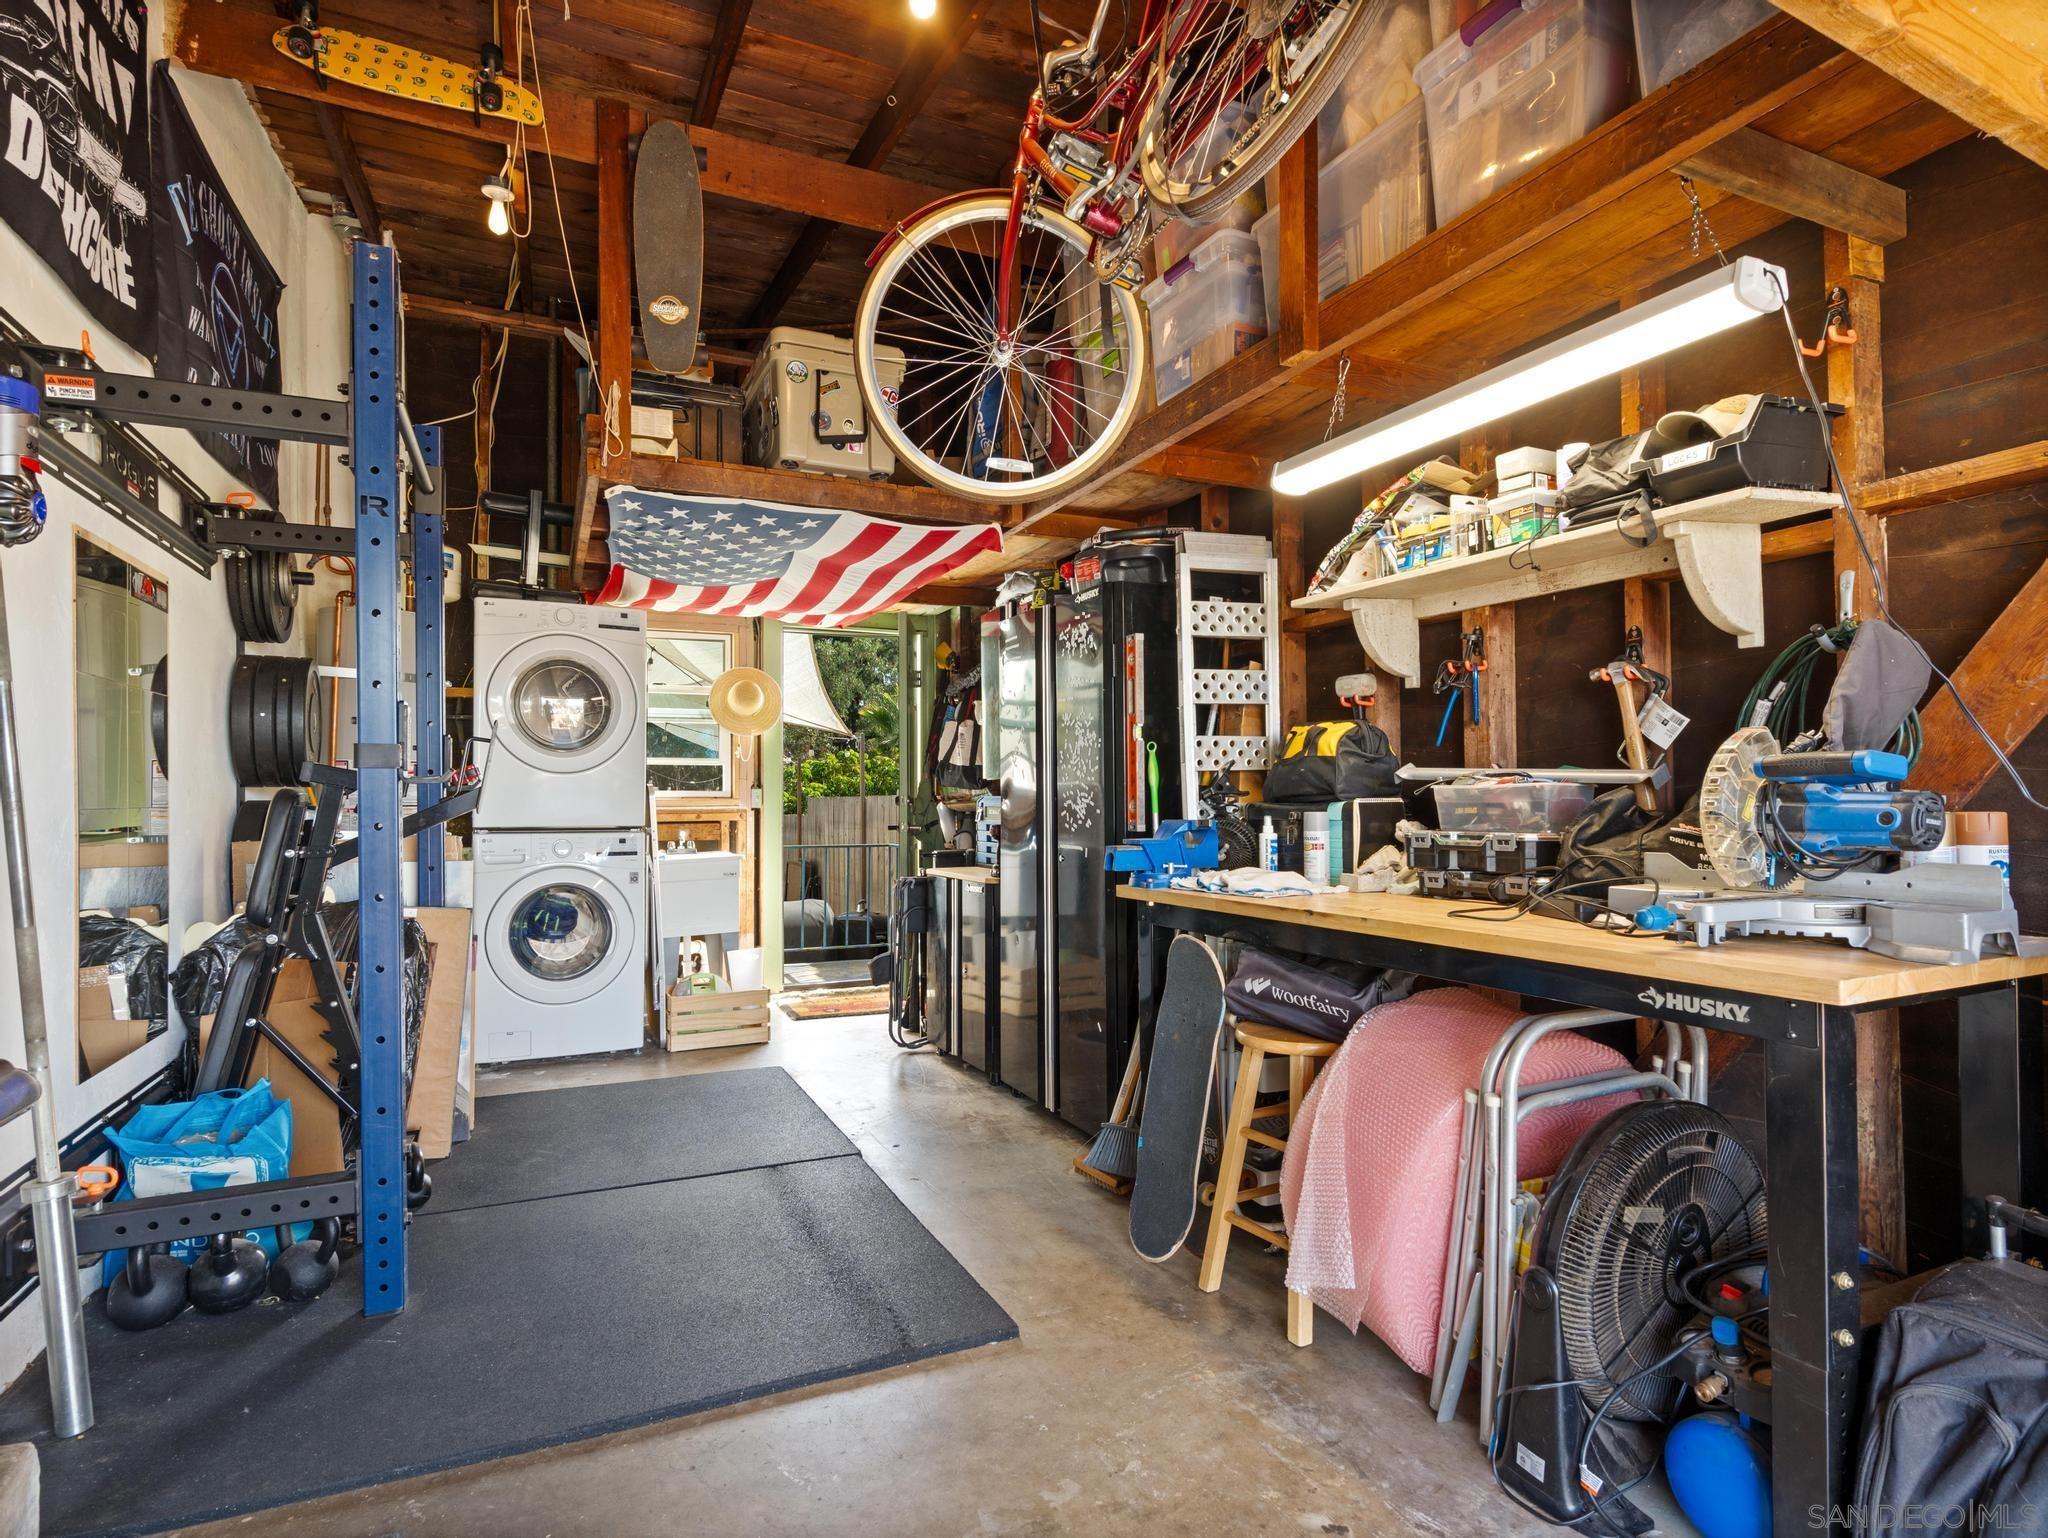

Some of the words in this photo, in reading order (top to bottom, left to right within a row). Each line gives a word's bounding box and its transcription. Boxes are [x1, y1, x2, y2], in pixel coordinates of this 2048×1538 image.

[57, 376, 93, 387] WARNING
[360, 495, 390, 517] R
[1080, 587, 1100, 603] HUSKY
[1669, 835, 1696, 848] DRIVE
[1271, 985, 1350, 1023] wootfairy
[1665, 991, 1751, 1023] HUSKY
